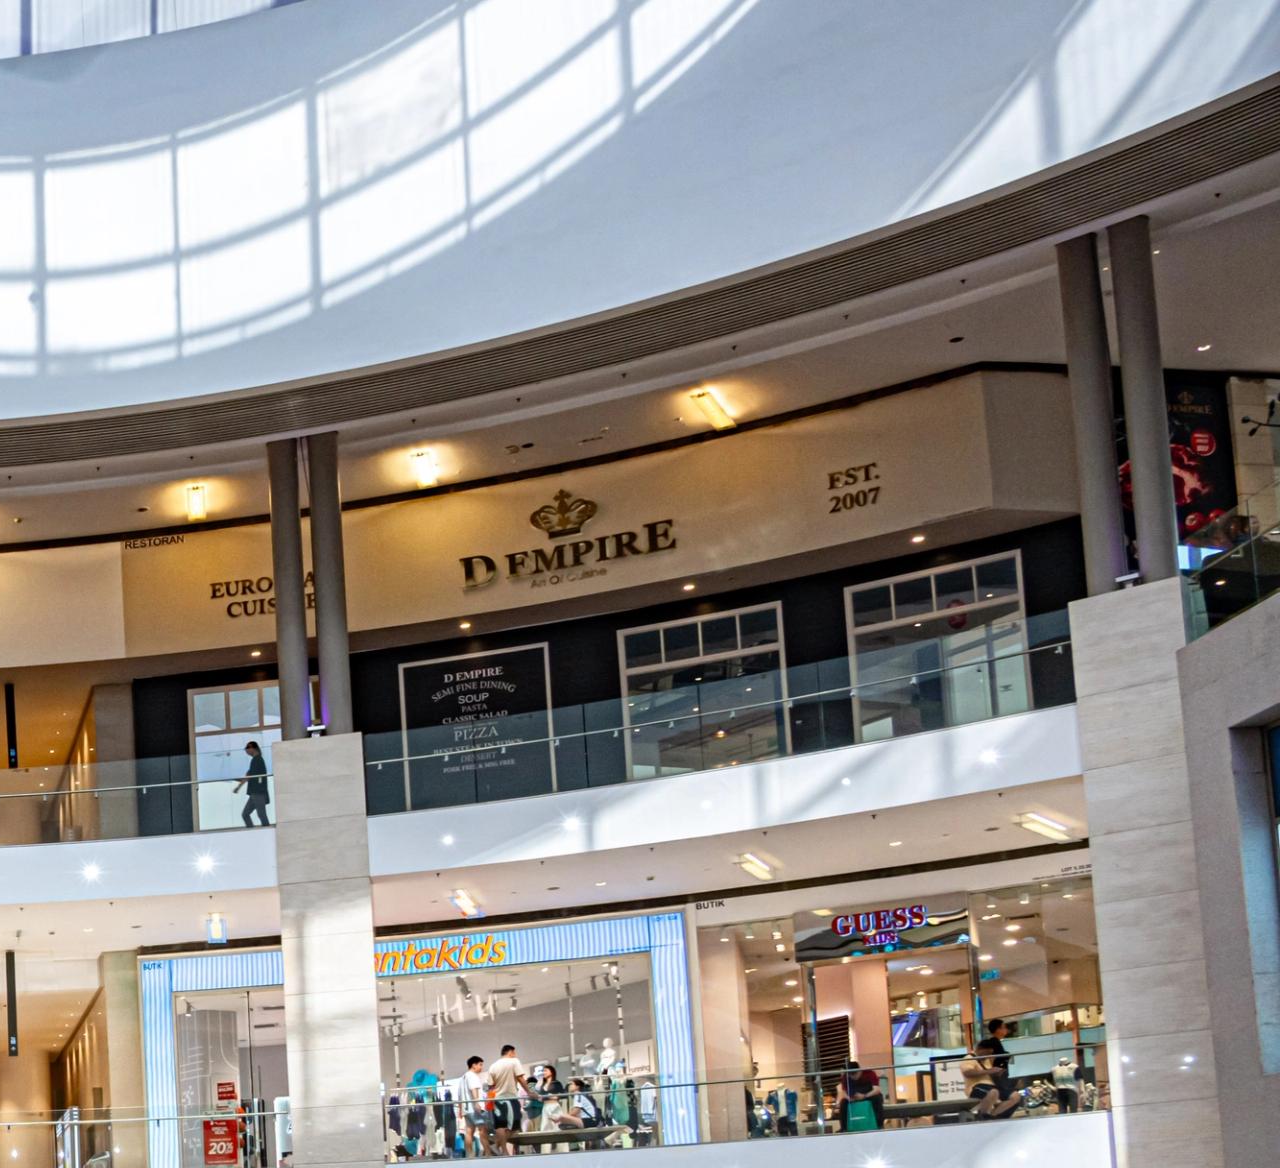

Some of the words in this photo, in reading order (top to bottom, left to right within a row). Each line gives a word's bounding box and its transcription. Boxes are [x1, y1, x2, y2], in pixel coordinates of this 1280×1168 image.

[828, 462, 880, 490] EST.
[829, 486, 881, 514] 2007
[124, 534, 185, 550] RESTORAN
[459, 554, 497, 594] D
[504, 518, 677, 581] EMPIRE
[455, 665, 504, 682] EMPIRE
[431, 687, 455, 703] SEMI
[456, 681, 478, 694] FINE
[480, 681, 517, 693] DINING
[458, 692, 490, 705] SOUP
[461, 703, 488, 714] PASTA
[454, 725, 499, 742] PIZZA
[695, 901, 726, 911] BUTIK
[831, 905, 927, 937] GUESS
